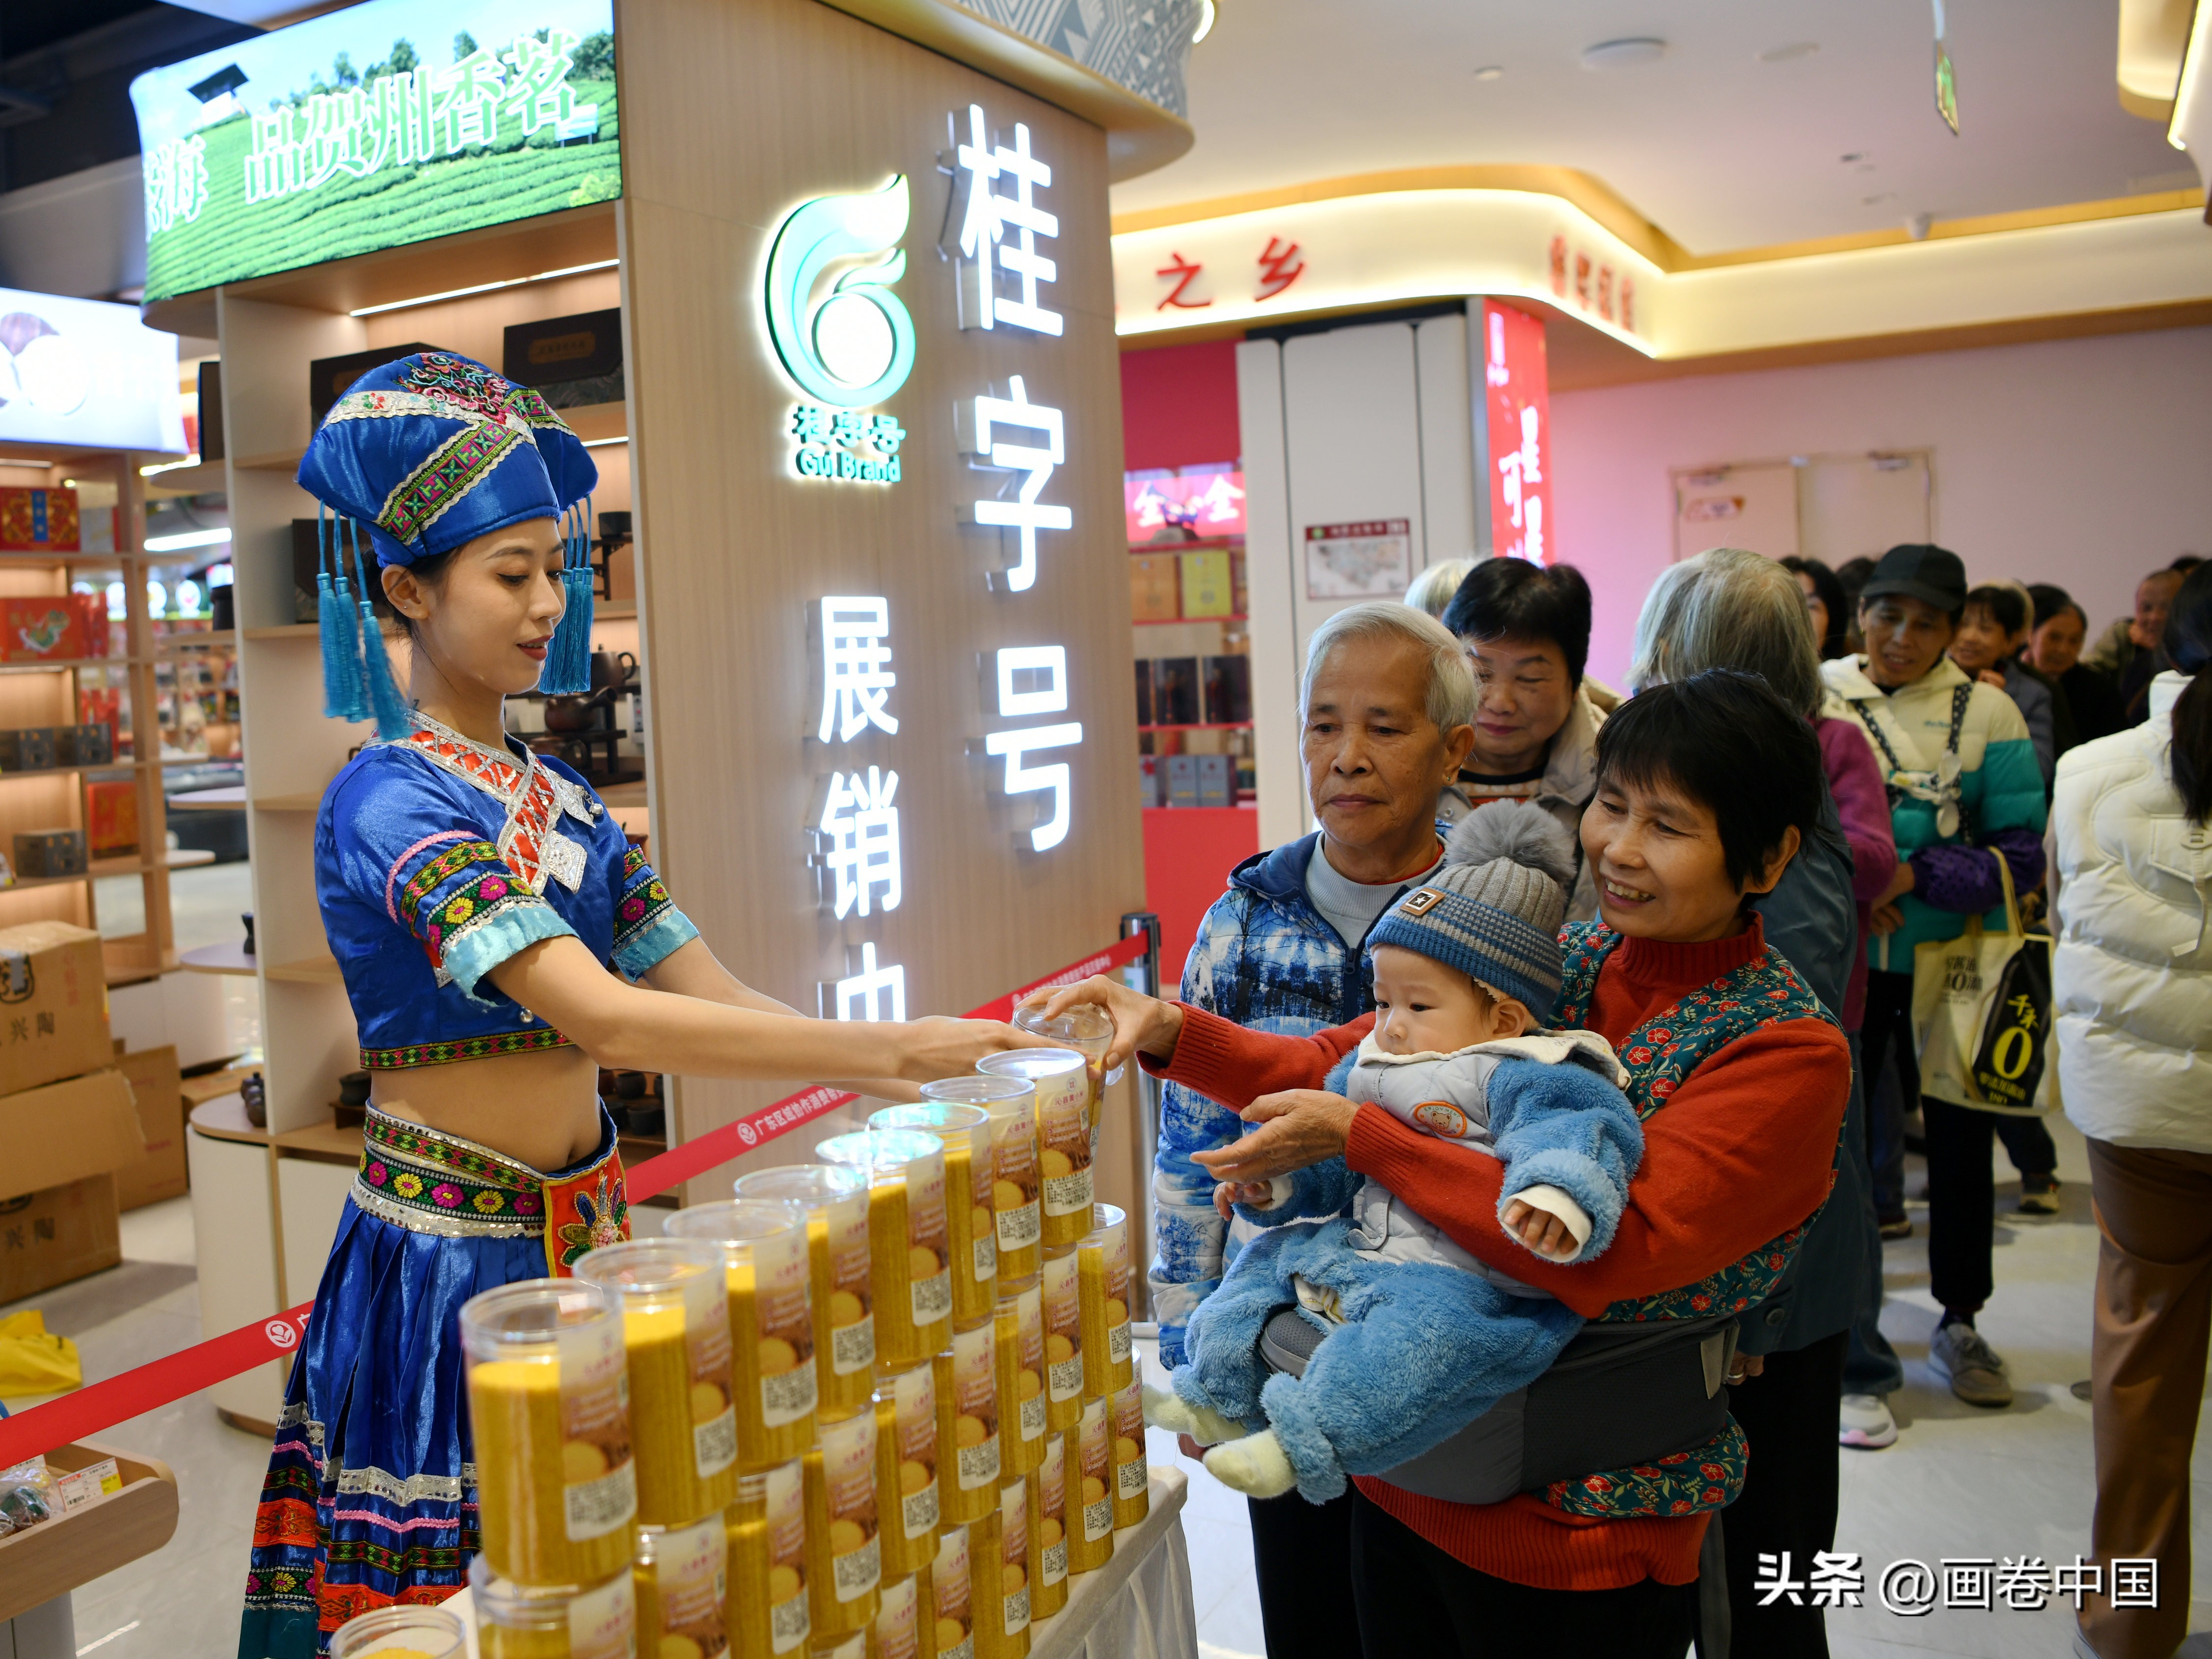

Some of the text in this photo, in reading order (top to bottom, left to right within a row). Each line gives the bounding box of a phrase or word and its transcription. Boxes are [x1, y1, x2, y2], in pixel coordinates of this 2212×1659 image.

[244, 28, 582, 204] 品贺州香茗
[1156, 237, 1305, 311] 之乡
[792, 405, 907, 454] 桂字号
[839, 451, 902, 482] Brand
[957, 103, 1083, 853] 桂字号
